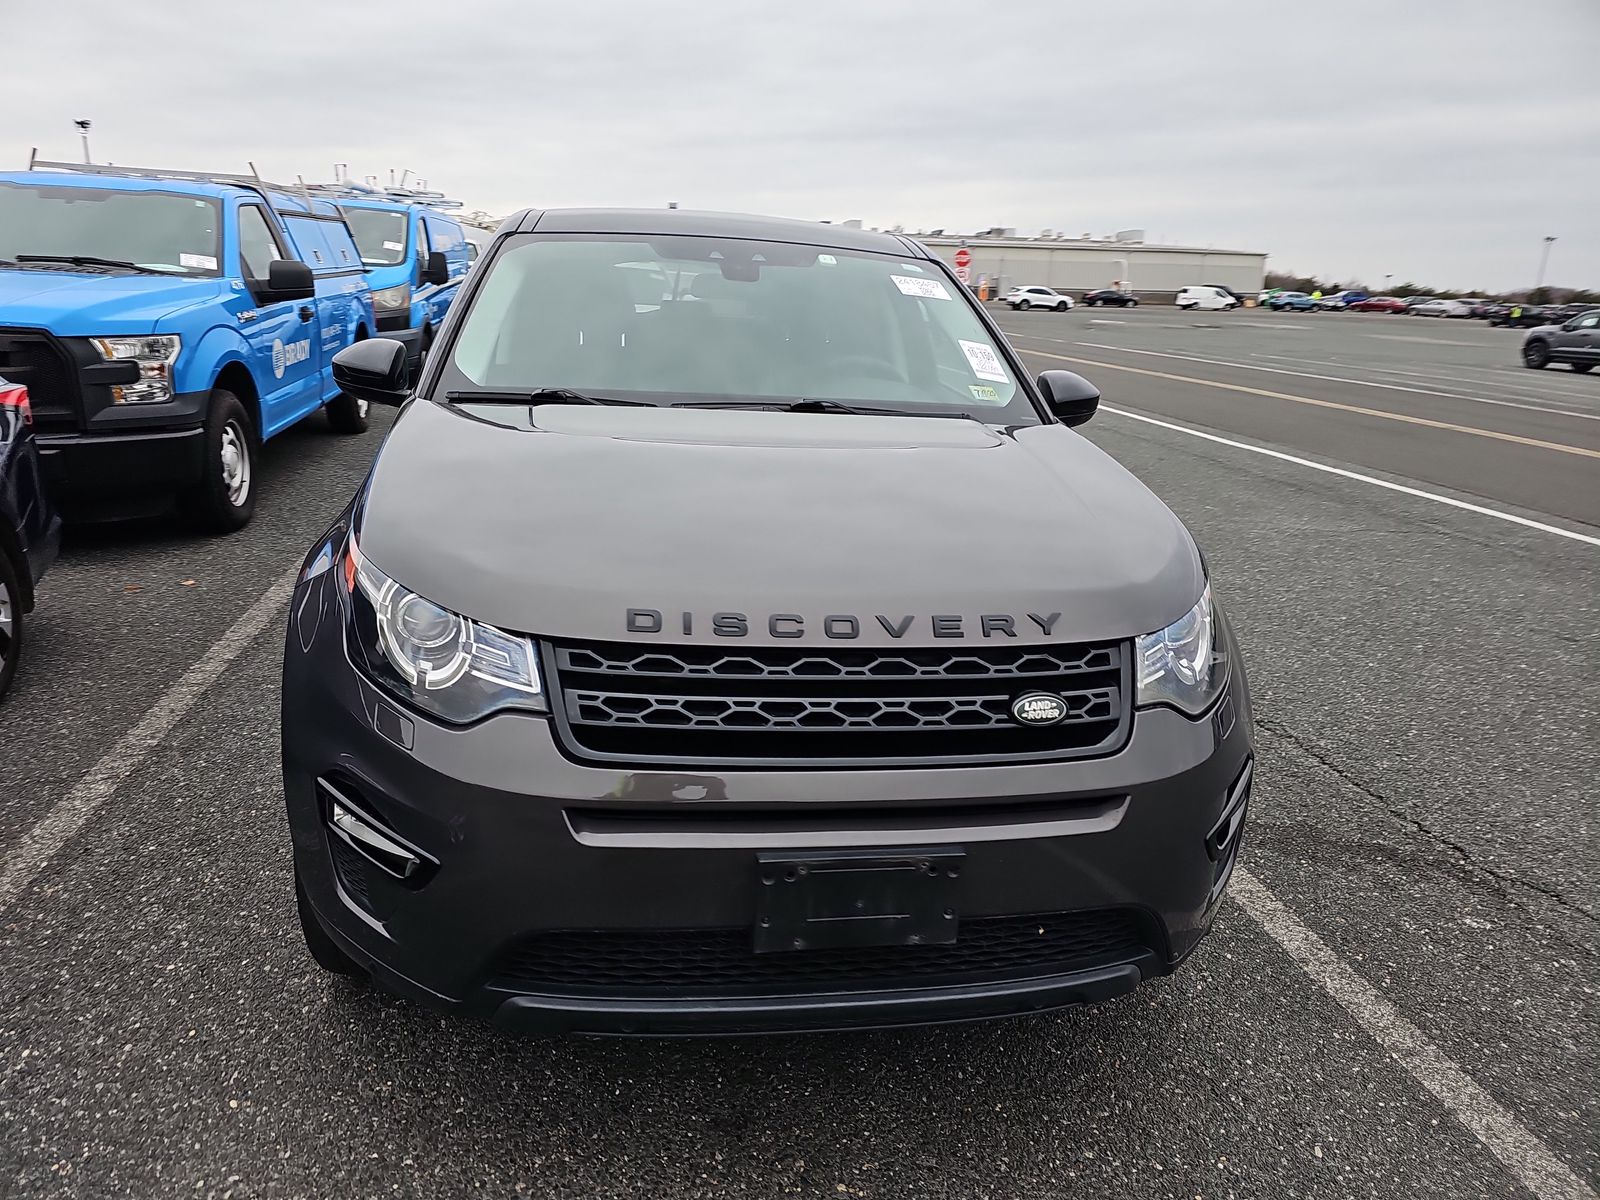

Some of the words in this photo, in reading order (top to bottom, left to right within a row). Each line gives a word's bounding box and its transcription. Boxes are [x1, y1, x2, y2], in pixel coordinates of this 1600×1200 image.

[626, 608, 1062, 639] DISCOVERY
[1024, 700, 1051, 711] LAND
[1027, 709, 1060, 720] ROVER
